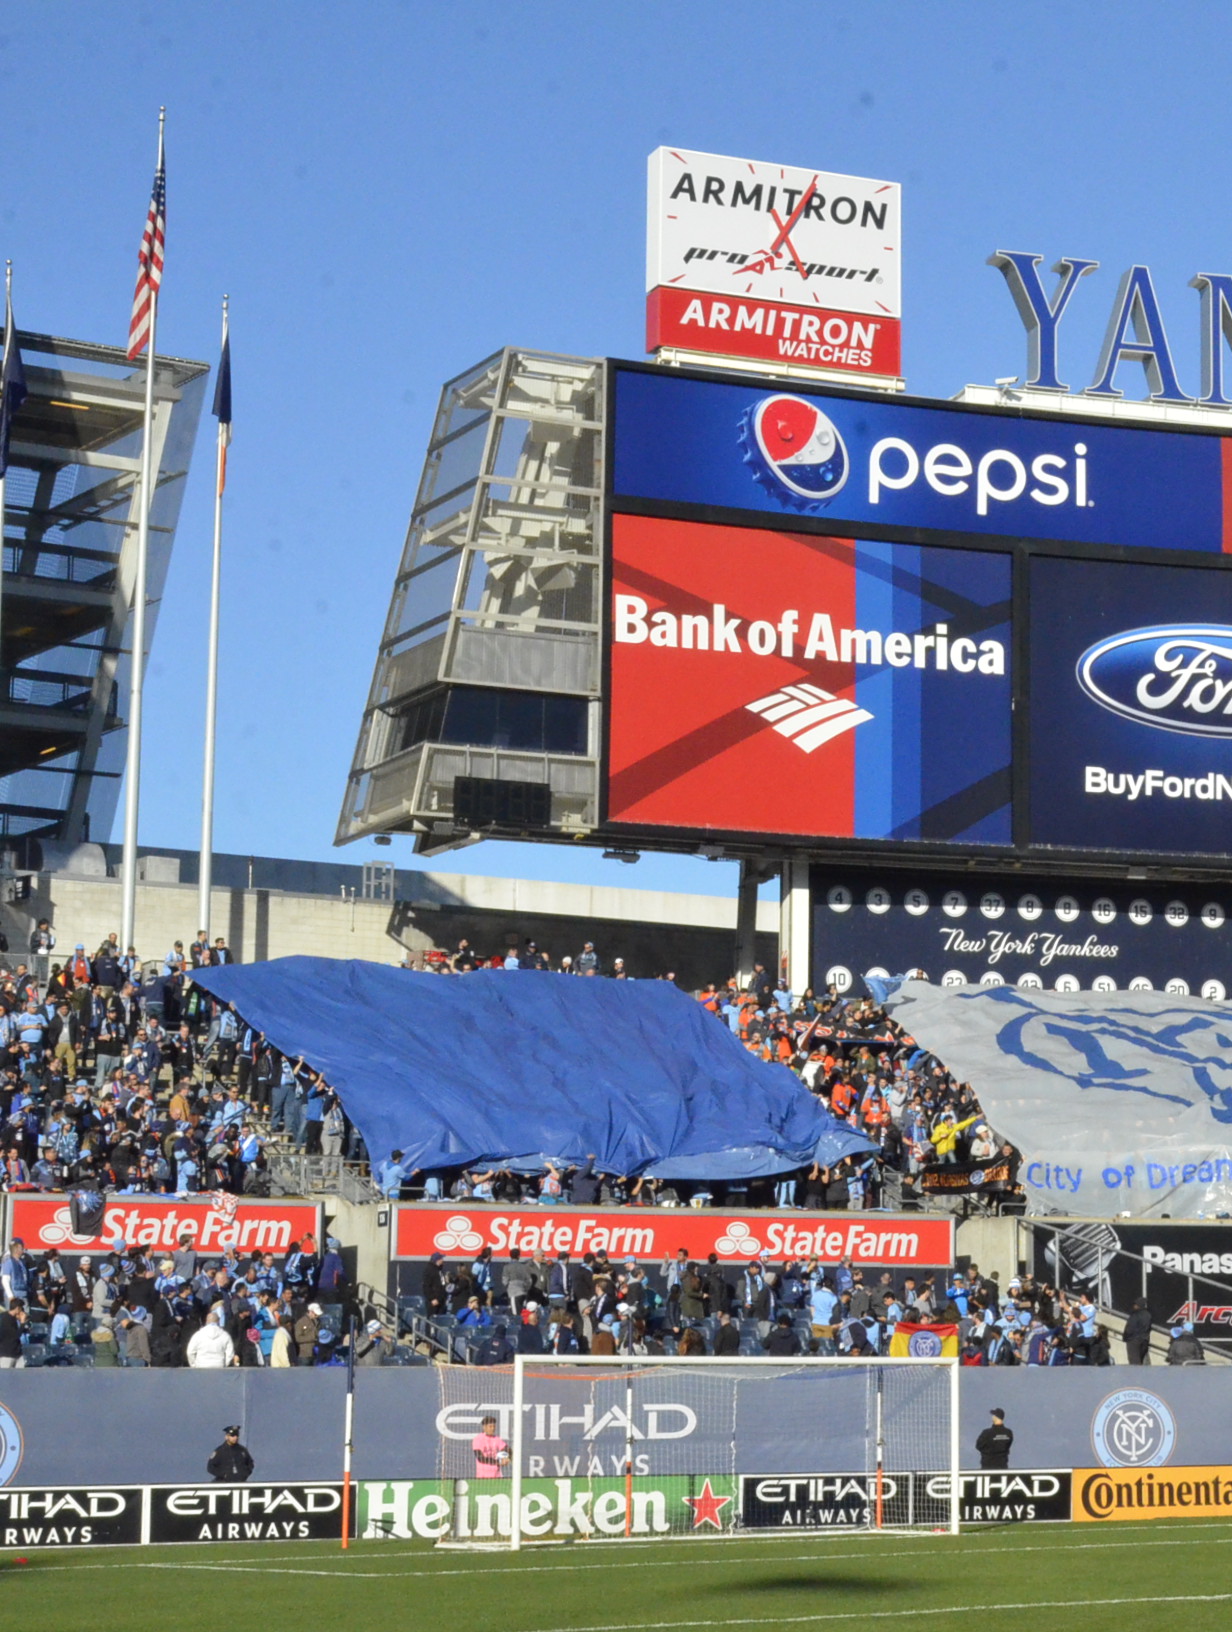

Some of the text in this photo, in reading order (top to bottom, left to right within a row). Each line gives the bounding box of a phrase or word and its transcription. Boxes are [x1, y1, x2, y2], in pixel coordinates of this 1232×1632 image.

[670, 172, 888, 230] ARMITRON
[683, 247, 749, 265] pro
[679, 299, 877, 350] ARMITRON
[778, 339, 872, 367] WATCHES
[869, 437, 1088, 516] pepsi
[614, 593, 1006, 676] Bank of America
[939, 927, 1119, 967] New York Yankees
[1026, 1162, 1082, 1193] City
[1101, 1164, 1135, 1189] of
[436, 1403, 697, 1440] ETIHAD
[529, 1454, 650, 1476] RWAYS
[756, 1478, 897, 1502] ETIHAD
[926, 1475, 1060, 1498] ETIHAD
[166, 1487, 341, 1516] ETIHAD
[362, 1478, 671, 1538] Heineken
[958, 1504, 1036, 1521] IRWAYS
[5, 1525, 93, 1545] RWAYS
[198, 1521, 310, 1540] AIRWAYS
